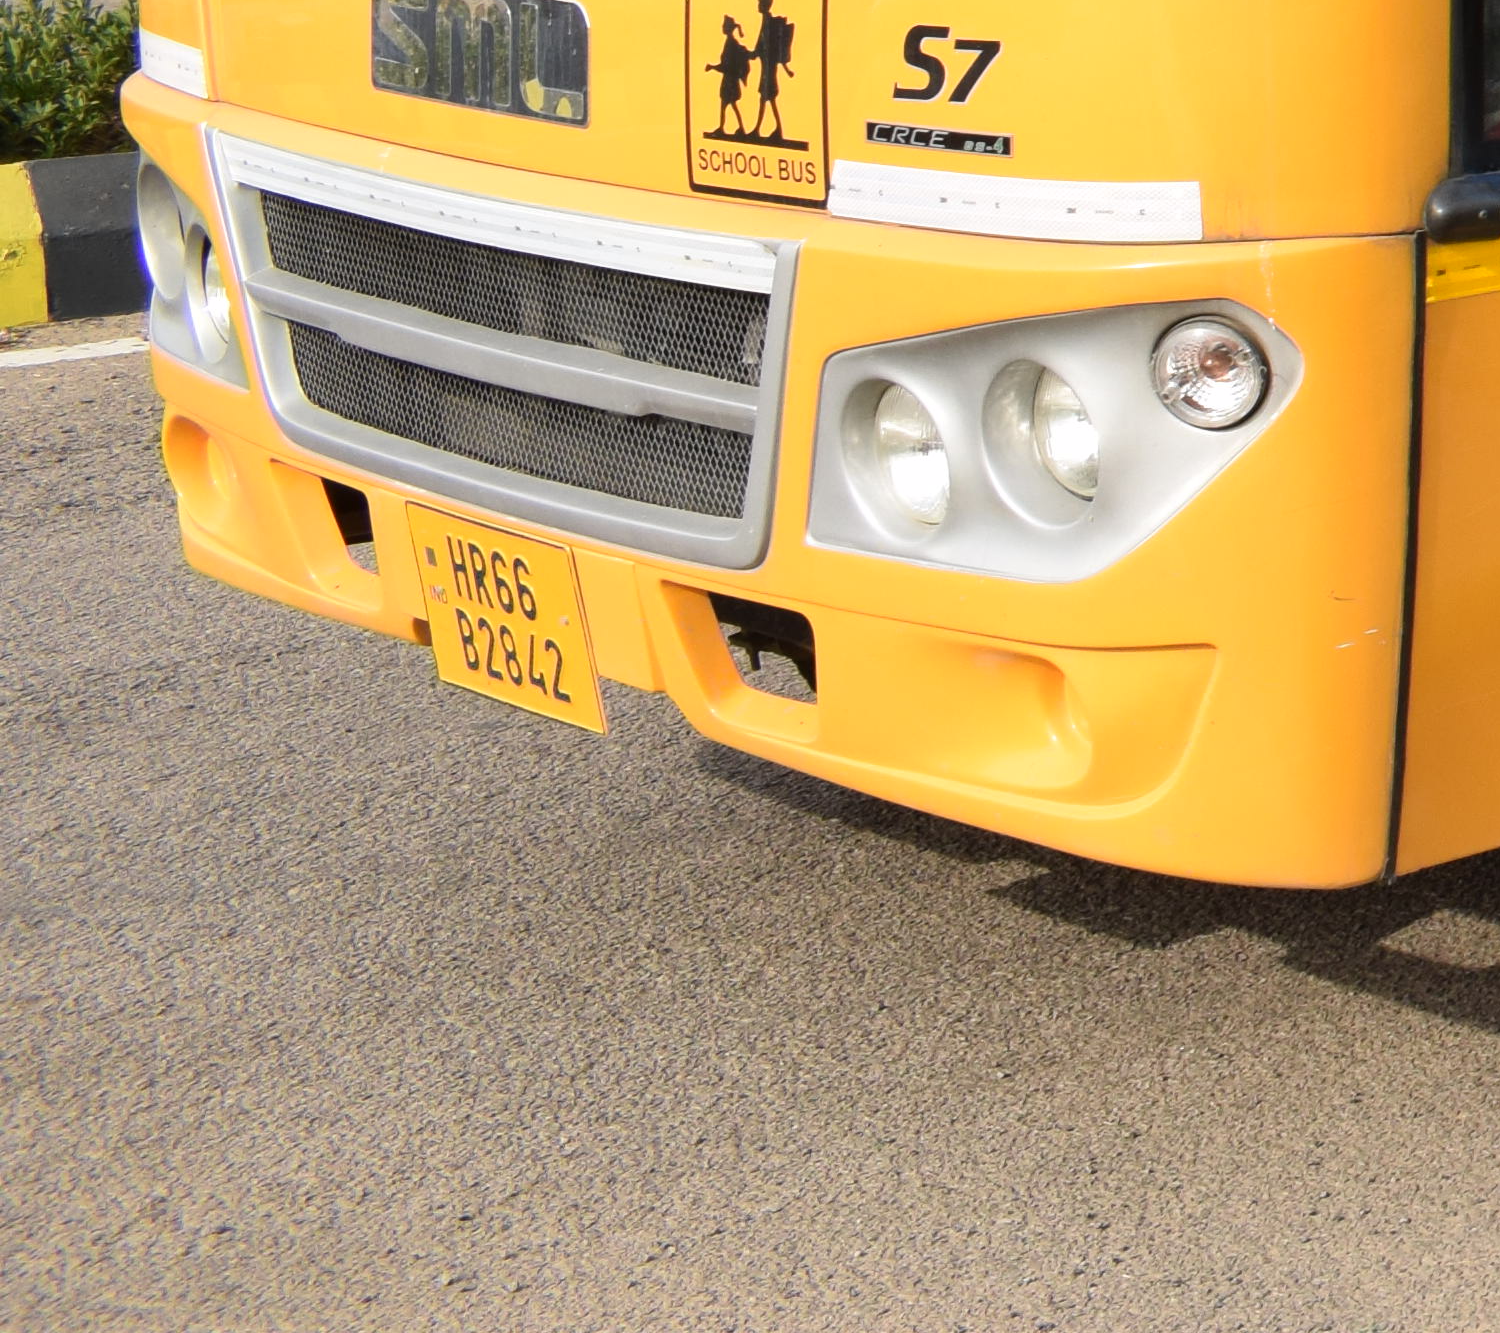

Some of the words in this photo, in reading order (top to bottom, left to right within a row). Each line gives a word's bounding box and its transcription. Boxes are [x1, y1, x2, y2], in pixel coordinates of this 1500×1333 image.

[892, 24, 1001, 104] S7
[698, 148, 773, 179] SCHOOL
[778, 158, 817, 185] BUS
[872, 124, 950, 149] CRCE
[446, 534, 538, 622] HR66
[455, 607, 572, 704] B2842
